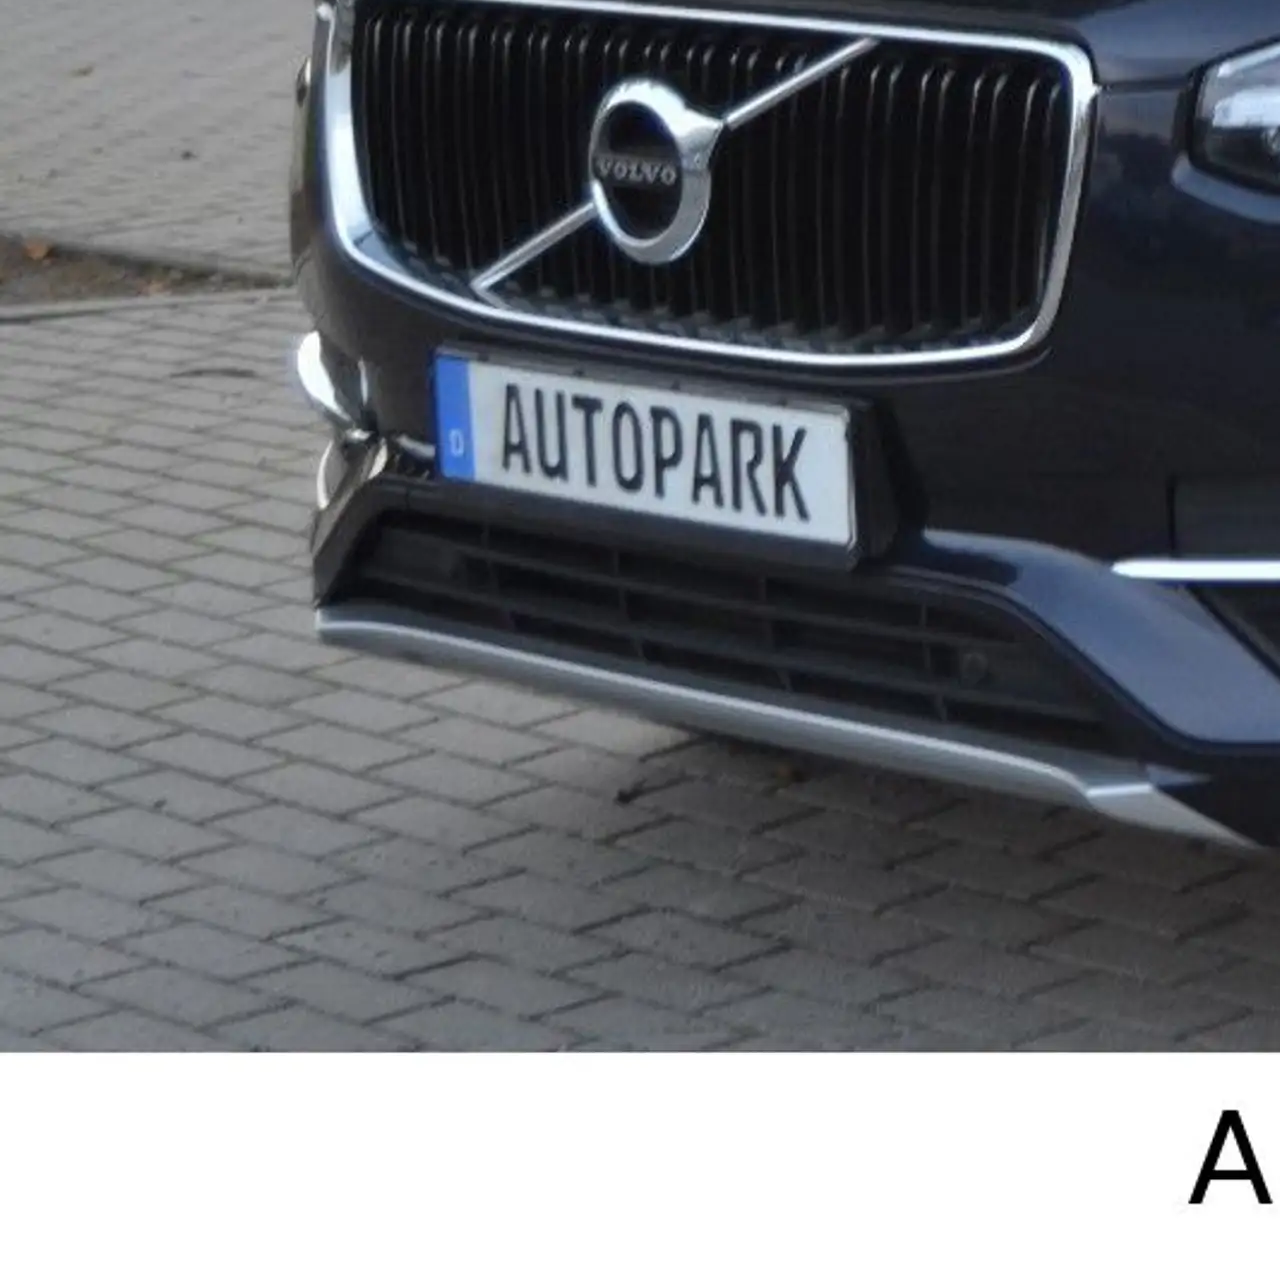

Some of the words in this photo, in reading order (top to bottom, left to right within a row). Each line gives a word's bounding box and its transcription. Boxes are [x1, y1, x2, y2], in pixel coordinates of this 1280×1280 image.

[596, 158, 678, 187] VOLVO
[449, 429, 464, 457] D
[502, 382, 809, 521] AUTOPARK
